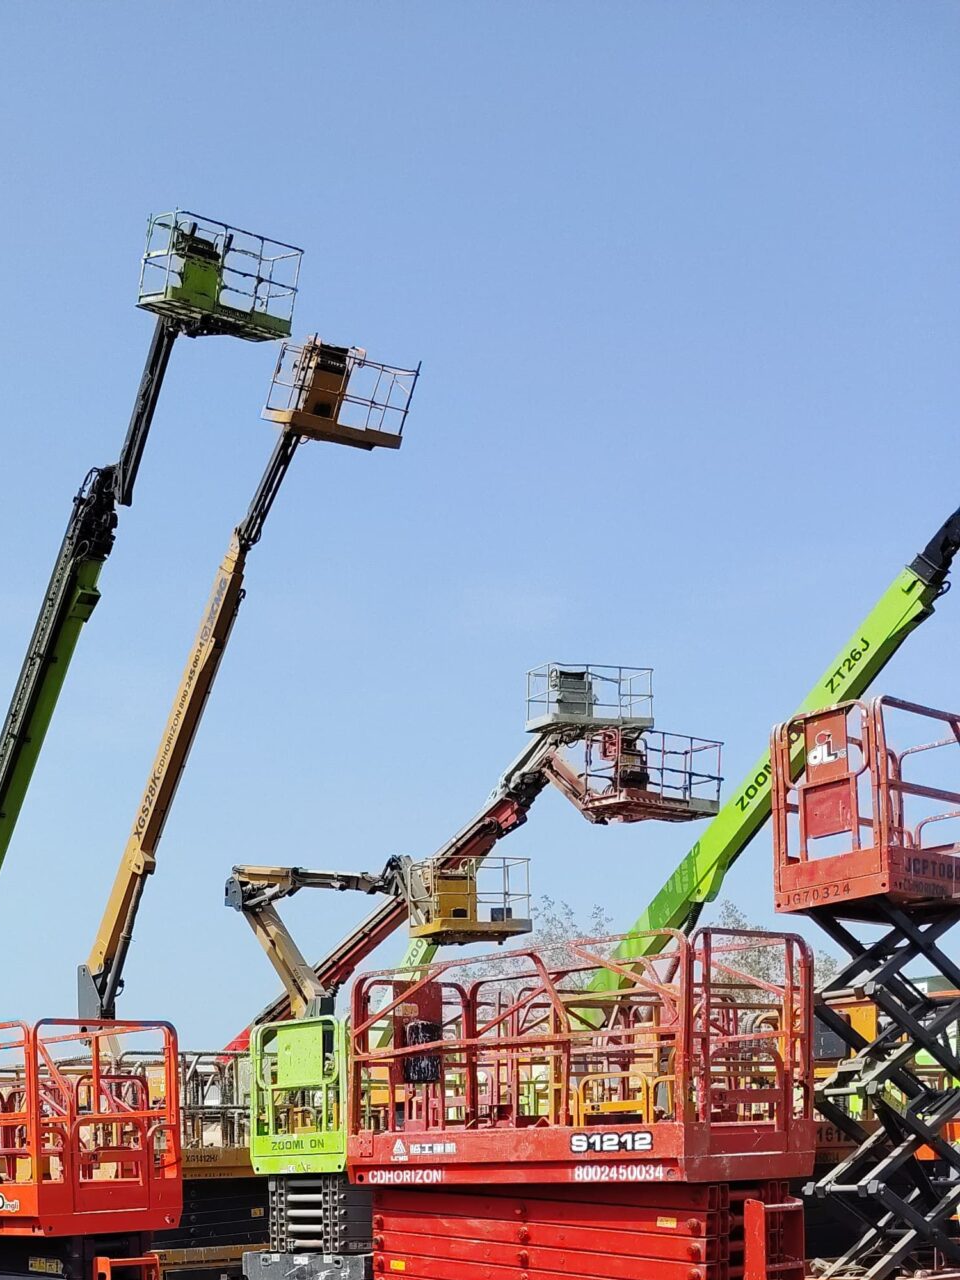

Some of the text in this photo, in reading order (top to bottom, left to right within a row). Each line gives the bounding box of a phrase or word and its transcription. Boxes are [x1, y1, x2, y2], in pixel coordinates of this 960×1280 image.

[825, 637, 870, 694] ZT26J
[133, 768, 160, 841] XGS28K
[157, 710, 182, 775] CDHORIZON
[784, 883, 851, 906] JG70324
[570, 1131, 653, 1153] S1212
[368, 1169, 442, 1183] CDHORIZON
[574, 1164, 664, 1181] 8002450034
